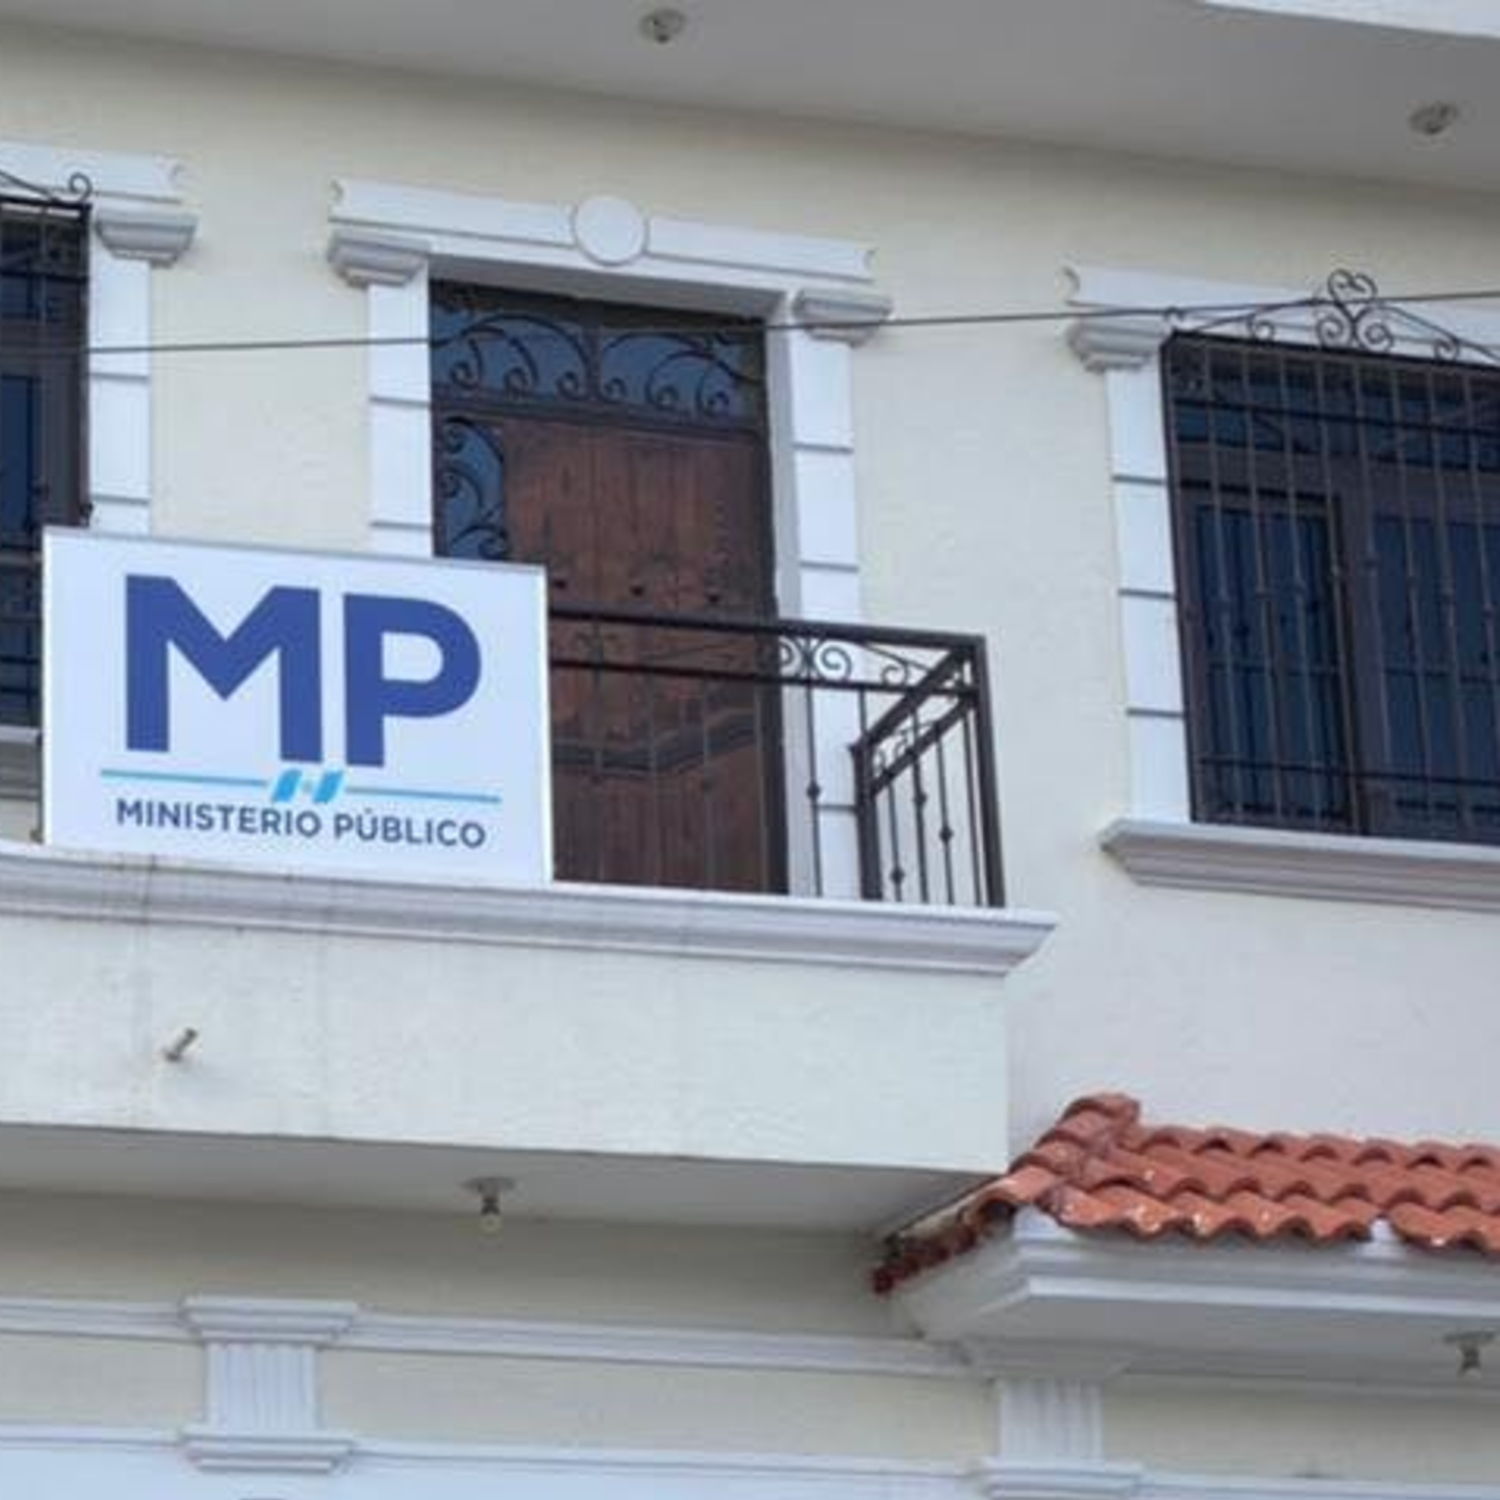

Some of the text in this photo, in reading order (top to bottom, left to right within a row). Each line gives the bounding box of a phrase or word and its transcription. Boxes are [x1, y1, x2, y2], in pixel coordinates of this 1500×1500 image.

[125, 573, 482, 768] MP
[115, 797, 486, 849] MINISTERIO PÚBLICO
